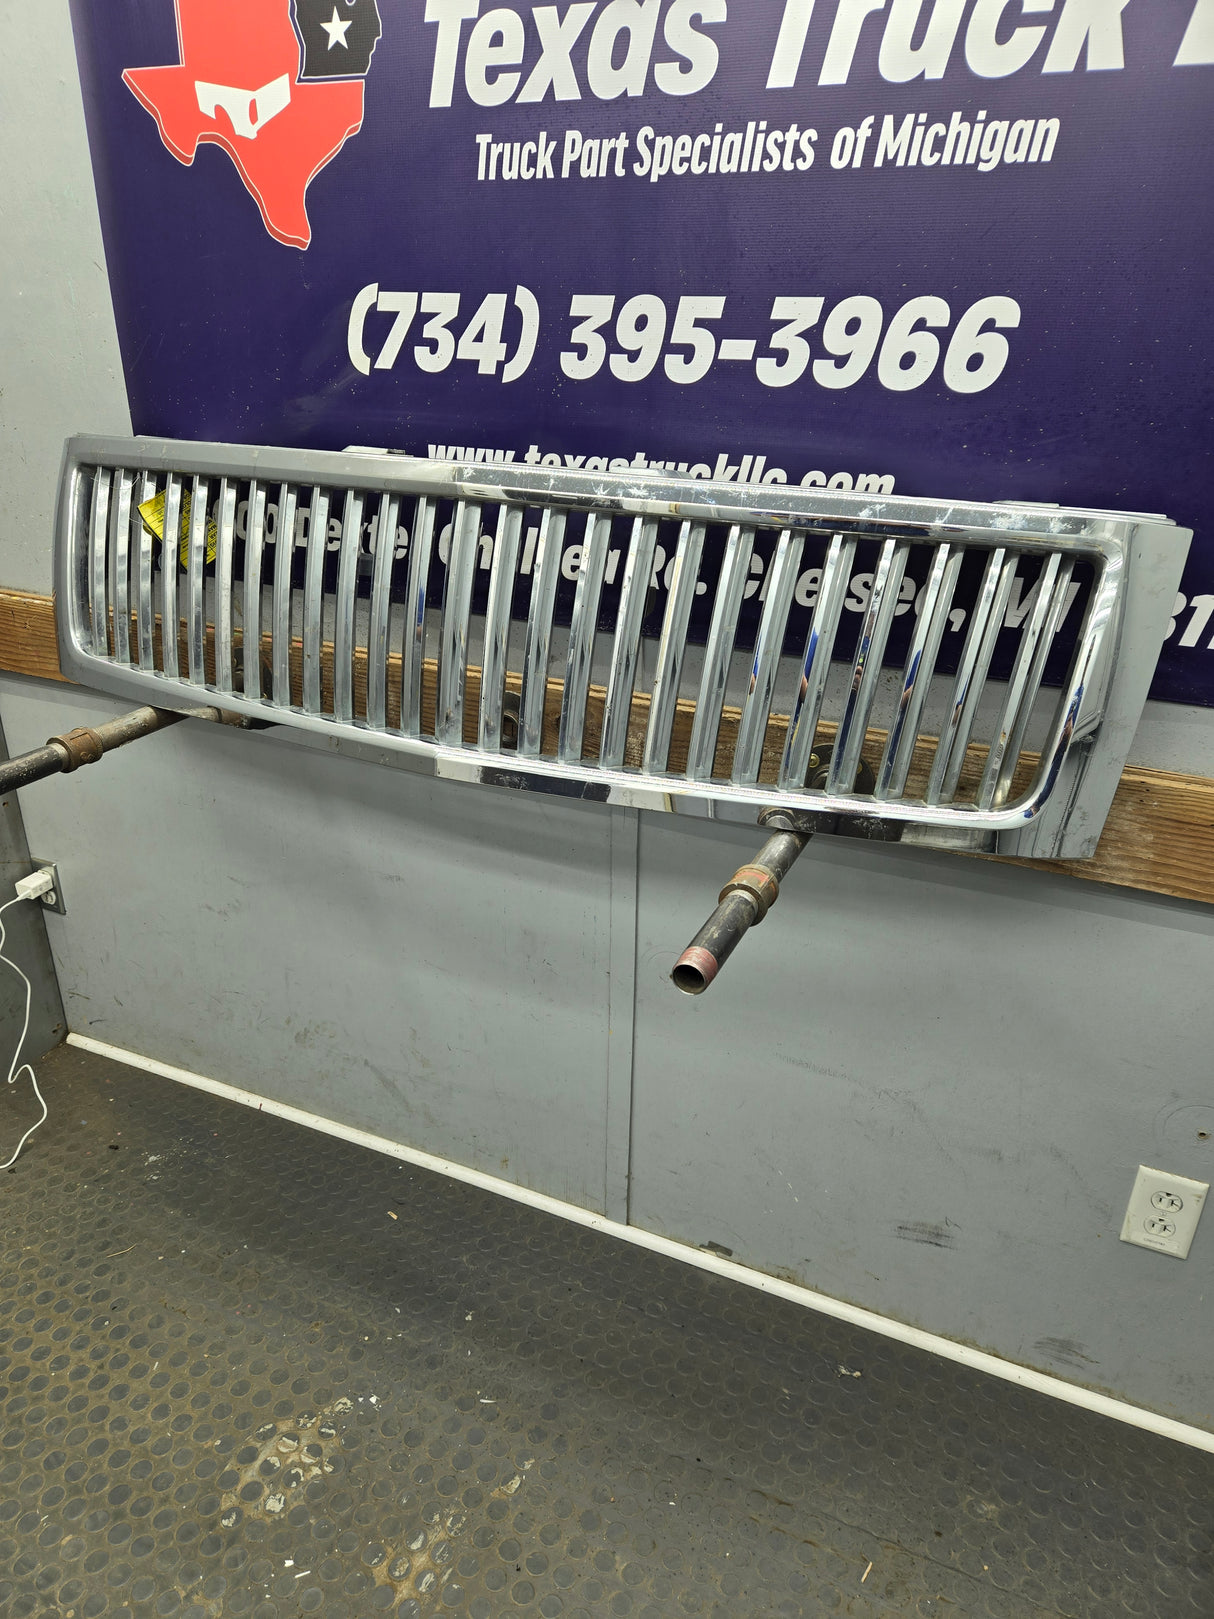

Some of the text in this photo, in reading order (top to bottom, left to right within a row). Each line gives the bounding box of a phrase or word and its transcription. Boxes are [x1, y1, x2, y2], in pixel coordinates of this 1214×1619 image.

[424, 0, 727, 108] Texas
[476, 110, 1061, 183] Truck Part Specialists of Michigan
[347, 282, 1021, 394] (734) 395-3966
